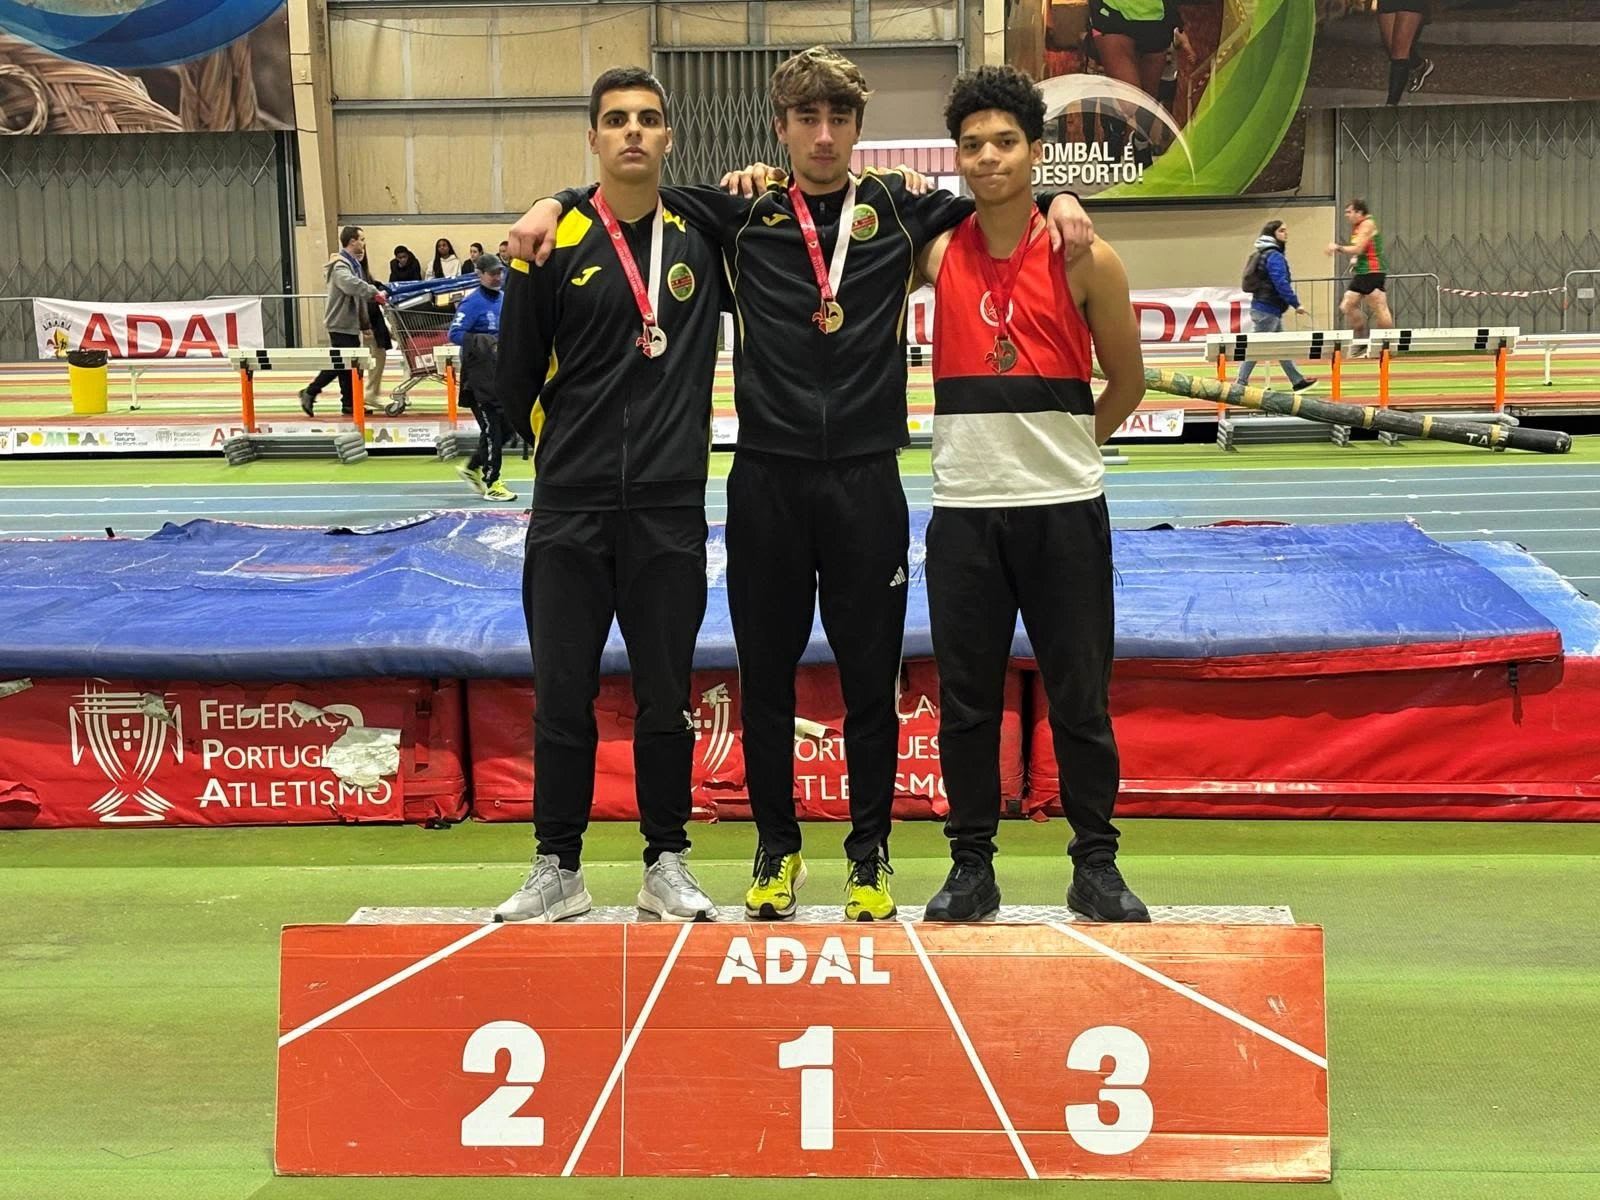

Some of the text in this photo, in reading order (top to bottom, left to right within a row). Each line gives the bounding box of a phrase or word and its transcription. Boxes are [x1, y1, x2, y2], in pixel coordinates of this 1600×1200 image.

[1041, 141, 1135, 164] OMBAL É
[1030, 162, 1144, 186] DESPORTO!
[1133, 300, 1242, 343] DAL
[16, 431, 112, 447] POMBAL
[202, 738, 329, 770] PORTUG
[199, 777, 392, 808] ATLETISMO
[716, 936, 891, 985] ADAL
[461, 1020, 545, 1147] 2
[778, 1025, 834, 1150] 1
[1064, 1025, 1154, 1155] 3
